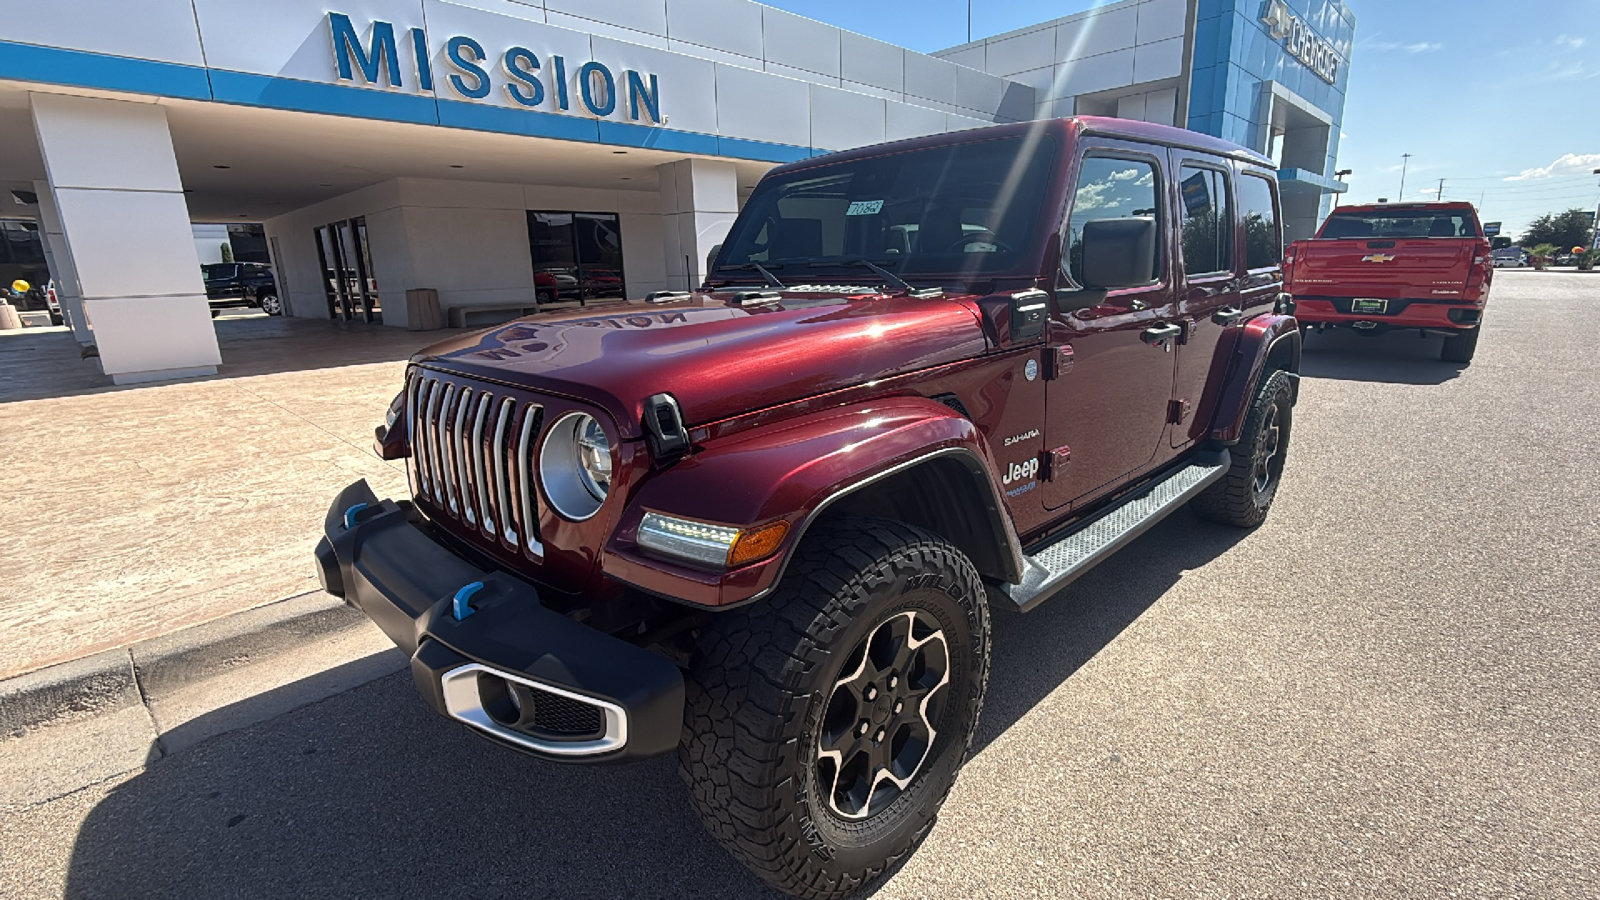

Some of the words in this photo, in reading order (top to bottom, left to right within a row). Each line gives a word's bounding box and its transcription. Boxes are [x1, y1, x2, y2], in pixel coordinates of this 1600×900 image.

[327, 12, 661, 125] MISSION
[1004, 429, 1040, 446] SAHARA
[1002, 457, 1039, 485] Jeep
